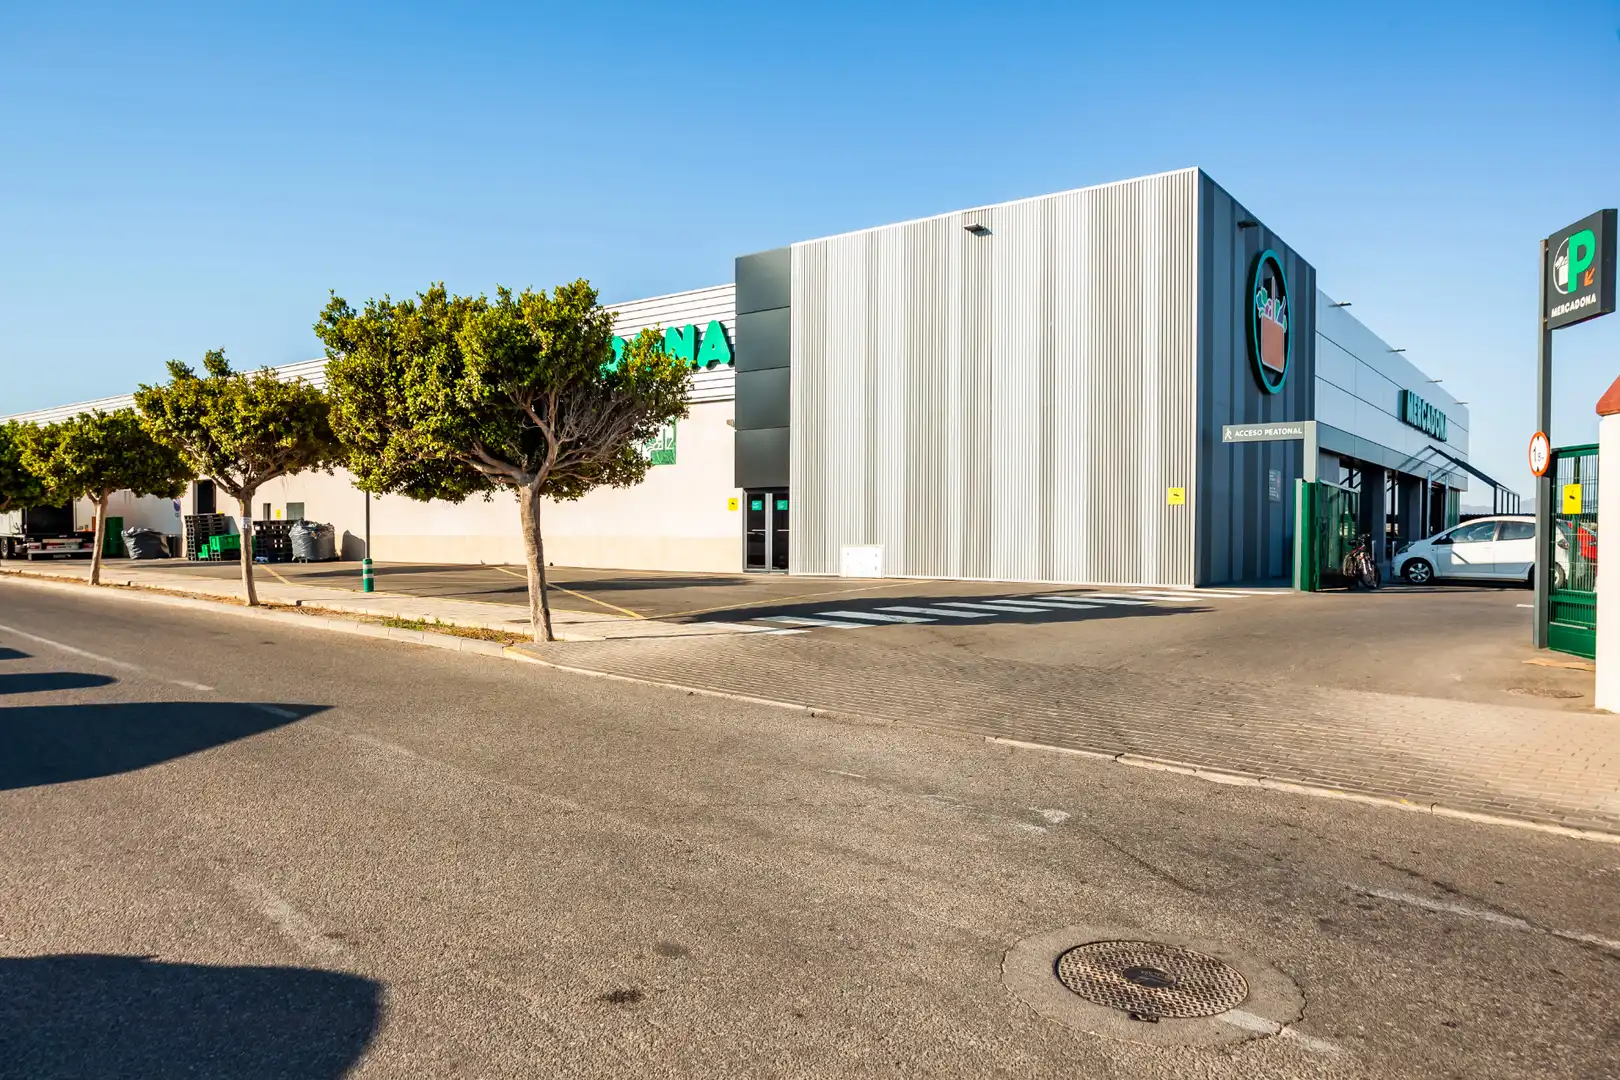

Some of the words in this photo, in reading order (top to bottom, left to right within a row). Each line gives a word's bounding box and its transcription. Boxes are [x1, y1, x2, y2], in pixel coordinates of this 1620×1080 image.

[1568, 228, 1595, 293] P
[1551, 292, 1597, 318] MERCADONA
[1234, 428, 1263, 437] ACCESO
[1264, 427, 1303, 436] PEATONAL
